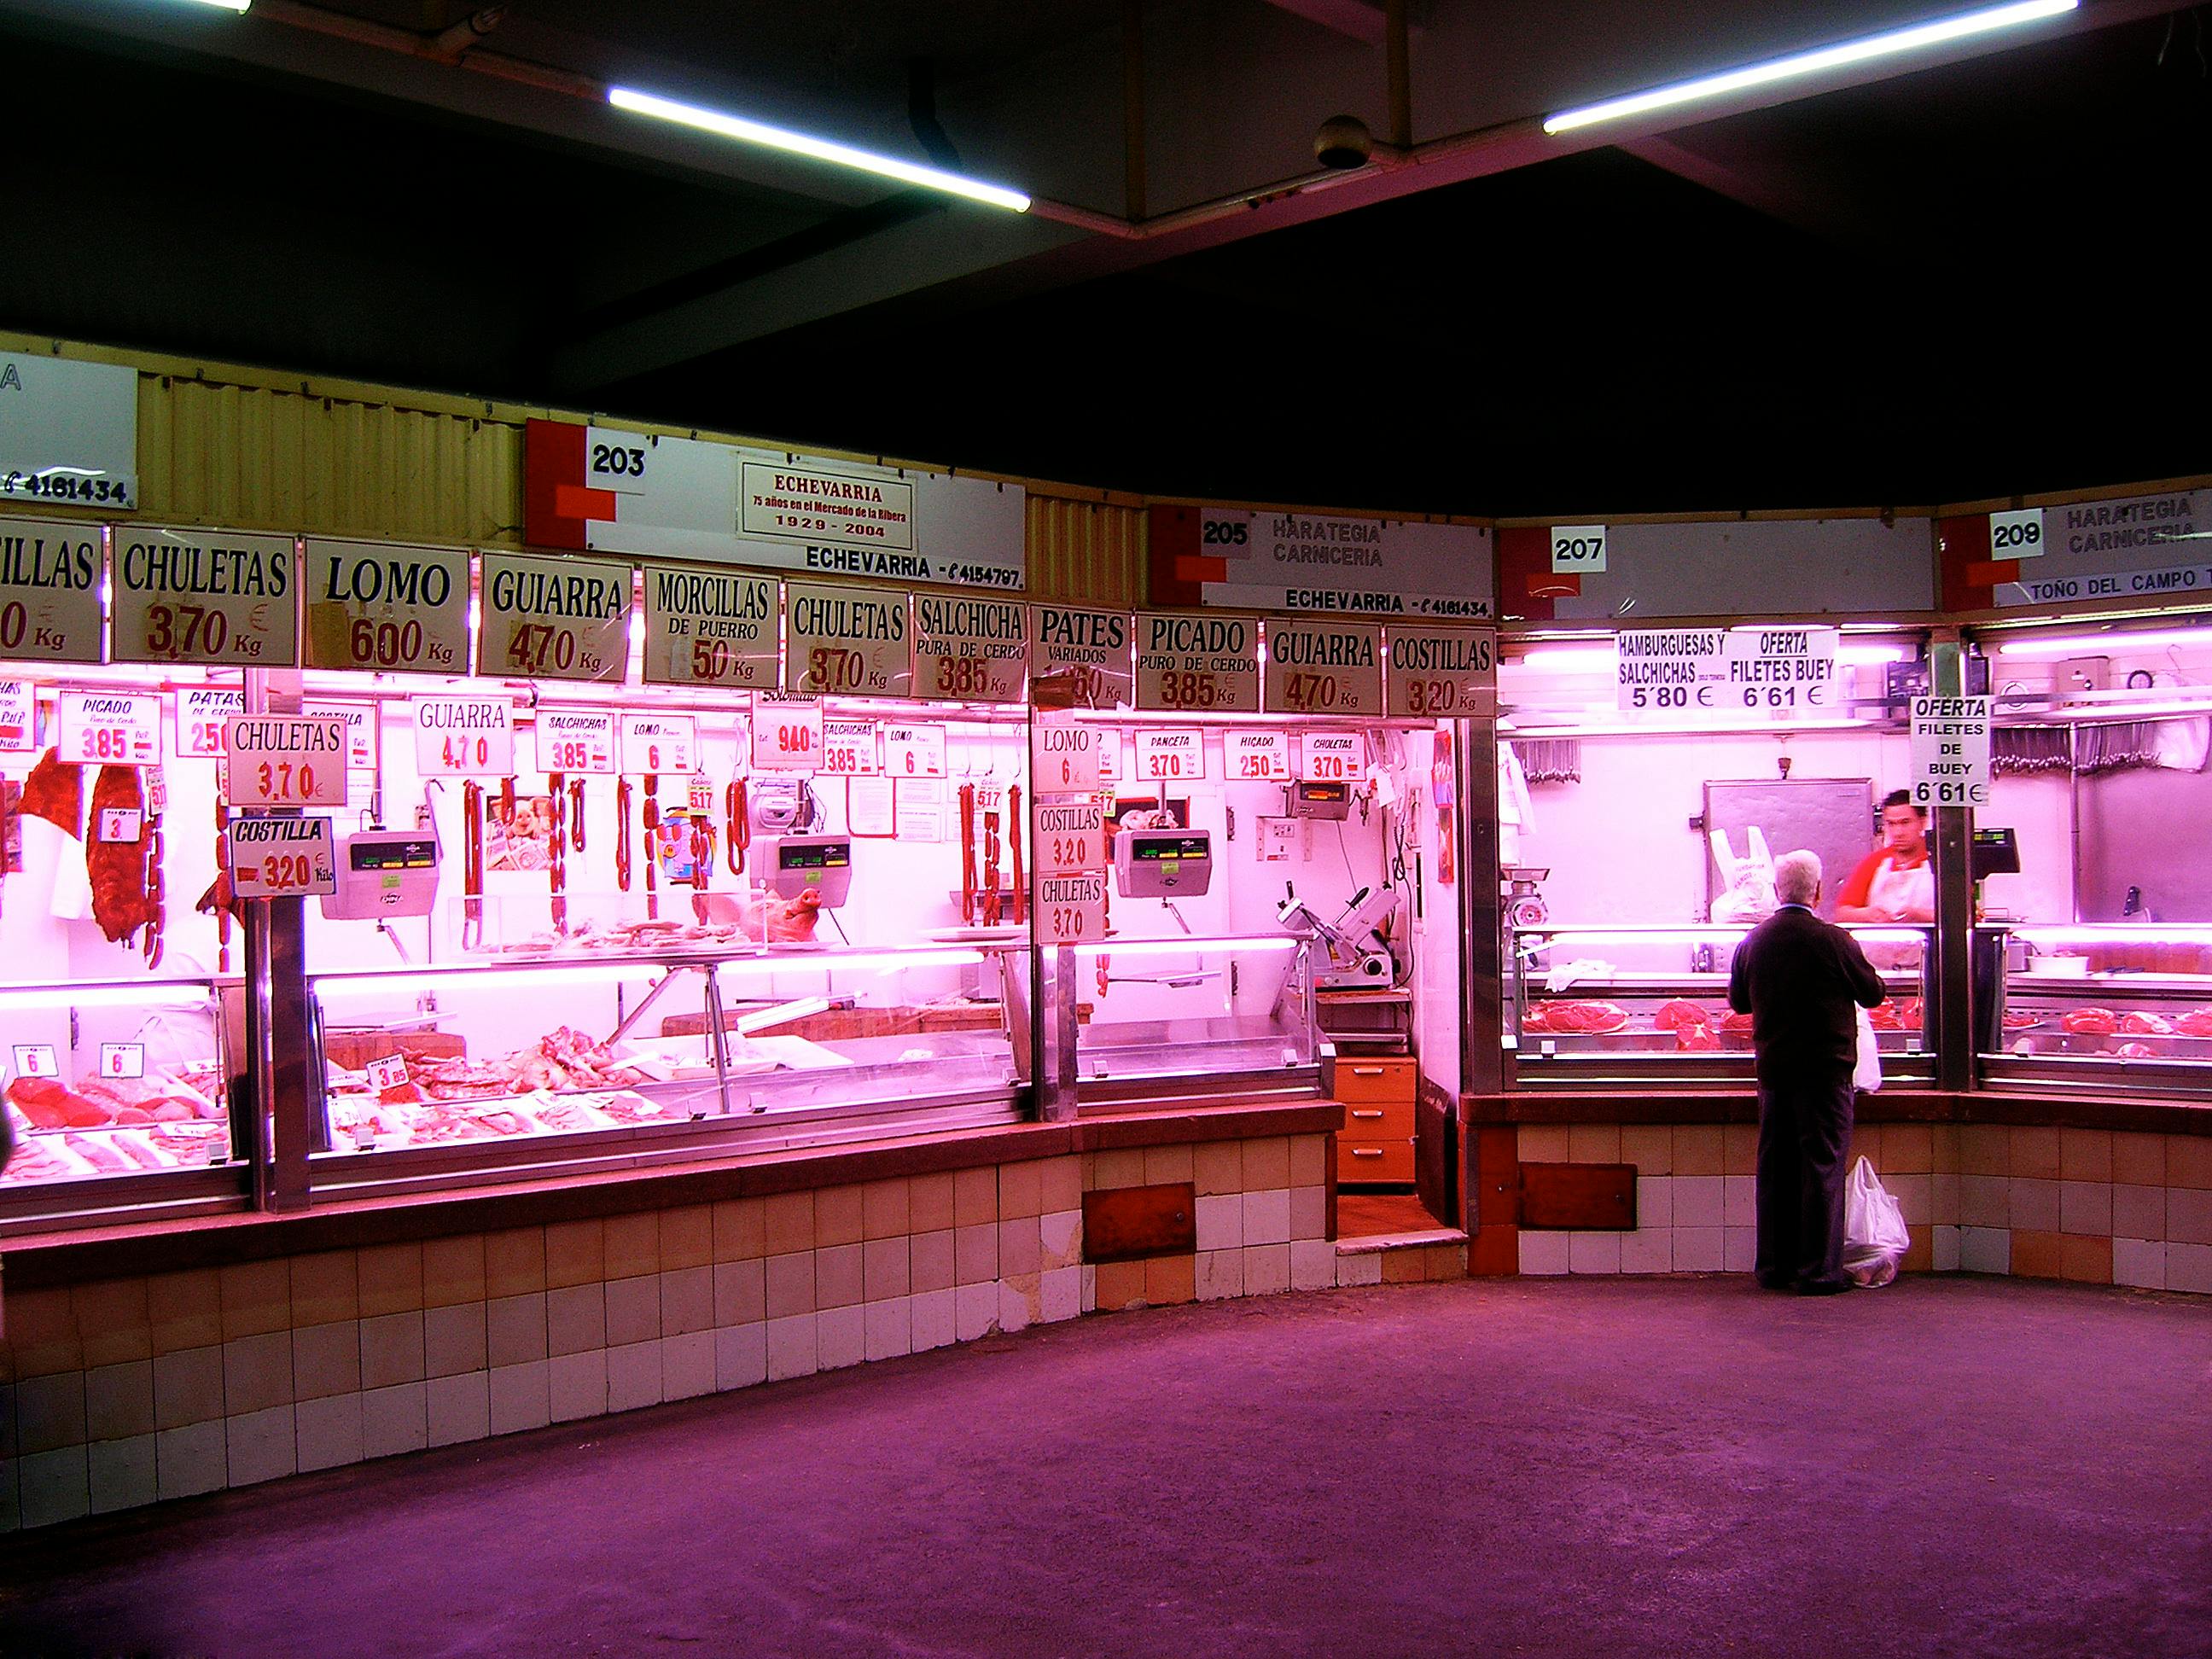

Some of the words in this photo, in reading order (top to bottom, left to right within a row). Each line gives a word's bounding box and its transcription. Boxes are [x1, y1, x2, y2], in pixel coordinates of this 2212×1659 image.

[593, 445, 645, 476] 203
[775, 474, 882, 503] ECHEVARRIA
[753, 495, 762, 506] 75
[765, 495, 789, 509] años
[790, 500, 802, 510] en
[804, 500, 813, 512] el
[814, 501, 853, 516] Mercado
[854, 506, 867, 518] de
[868, 508, 877, 520] la
[878, 509, 906, 523] Ribera
[2067, 498, 2193, 529] HARATEGIA
[776, 515, 826, 530] 1929
[845, 522, 885, 538] 2004
[1203, 521, 1247, 544] 205
[1273, 519, 1381, 544] HARATEGIA
[1994, 523, 2040, 549] 209
[1556, 538, 1603, 560] 207
[2069, 523, 2196, 553] CARNICERIA
[0, 537, 93, 591] ILLAS
[806, 546, 930, 579] ECHEVARRIA
[1273, 544, 1382, 567] CARNICERIA
[124, 543, 287, 597] CHULETAS
[326, 556, 451, 607] LOMO
[2032, 579, 2078, 601] TOÑO
[2088, 578, 2121, 595] DEL
[2132, 570, 2195, 591] CAMPO
[492, 569, 623, 620] GUIARRA
[657, 573, 768, 620] MORCILLAS
[1286, 589, 1403, 612] ECHEVARRIA
[668, 617, 690, 635] DE
[699, 621, 758, 639] PUERRO
[795, 597, 903, 641] CHULETAS
[920, 598, 1022, 641] SALCHICHA
[1040, 609, 1124, 649] PATES
[34, 628, 66, 650] Kg
[233, 634, 262, 655] Kg
[1150, 619, 1244, 654] PICADO
[1619, 634, 1714, 655] HAMBURGUESAS
[1717, 634, 1725, 655] Y
[1761, 632, 1807, 654] OFERTA
[428, 642, 452, 663] Kg
[917, 640, 952, 656] PURA
[959, 643, 976, 657] DE
[984, 643, 1025, 661] CERDO
[1049, 646, 1106, 664] VARIADOS
[1273, 632, 1374, 667] GUIARRA
[1393, 637, 1490, 672] COSTILLAS
[579, 651, 601, 672] Kg
[733, 661, 754, 679] Kg
[1139, 655, 1176, 670] PURO
[1185, 657, 1203, 671] DE
[1211, 657, 1257, 672] CERDO
[1731, 661, 1790, 682] FILETES
[1796, 659, 1834, 680] BUEY
[868, 672, 888, 690] Kg
[1620, 662, 1695, 684] SALCHICHAS
[990, 678, 1006, 695] Kg
[1106, 685, 1121, 701] Kg
[1217, 689, 1236, 704] Kg
[83, 699, 132, 713] PICADO
[1341, 693, 1359, 708] Kg
[1459, 696, 1476, 710] Kg
[1916, 699, 1986, 716] OFERTA
[420, 703, 505, 729] GUIARRA
[549, 717, 607, 730] SALCHICHAS
[236, 721, 340, 752] CHULETAS
[634, 724, 660, 735] LOMO
[824, 724, 871, 736] SALCHICHAS
[890, 730, 912, 742] LOMO
[1044, 730, 1089, 751] LOMO
[1918, 724, 1983, 735] FILETES
[1150, 736, 1190, 747] PANCETA
[1941, 743, 1961, 754] DE
[649, 745, 660, 770] 6
[905, 751, 915, 773] 6
[1062, 758, 1070, 784] 6
[1929, 763, 1972, 775] BUEY
[236, 821, 322, 841] COSTILLA
[1040, 808, 1100, 832] COSTILLAS
[1042, 879, 1101, 903] CHULETAS
[27, 1055, 38, 1072] 6
[113, 1054, 122, 1073] 6
